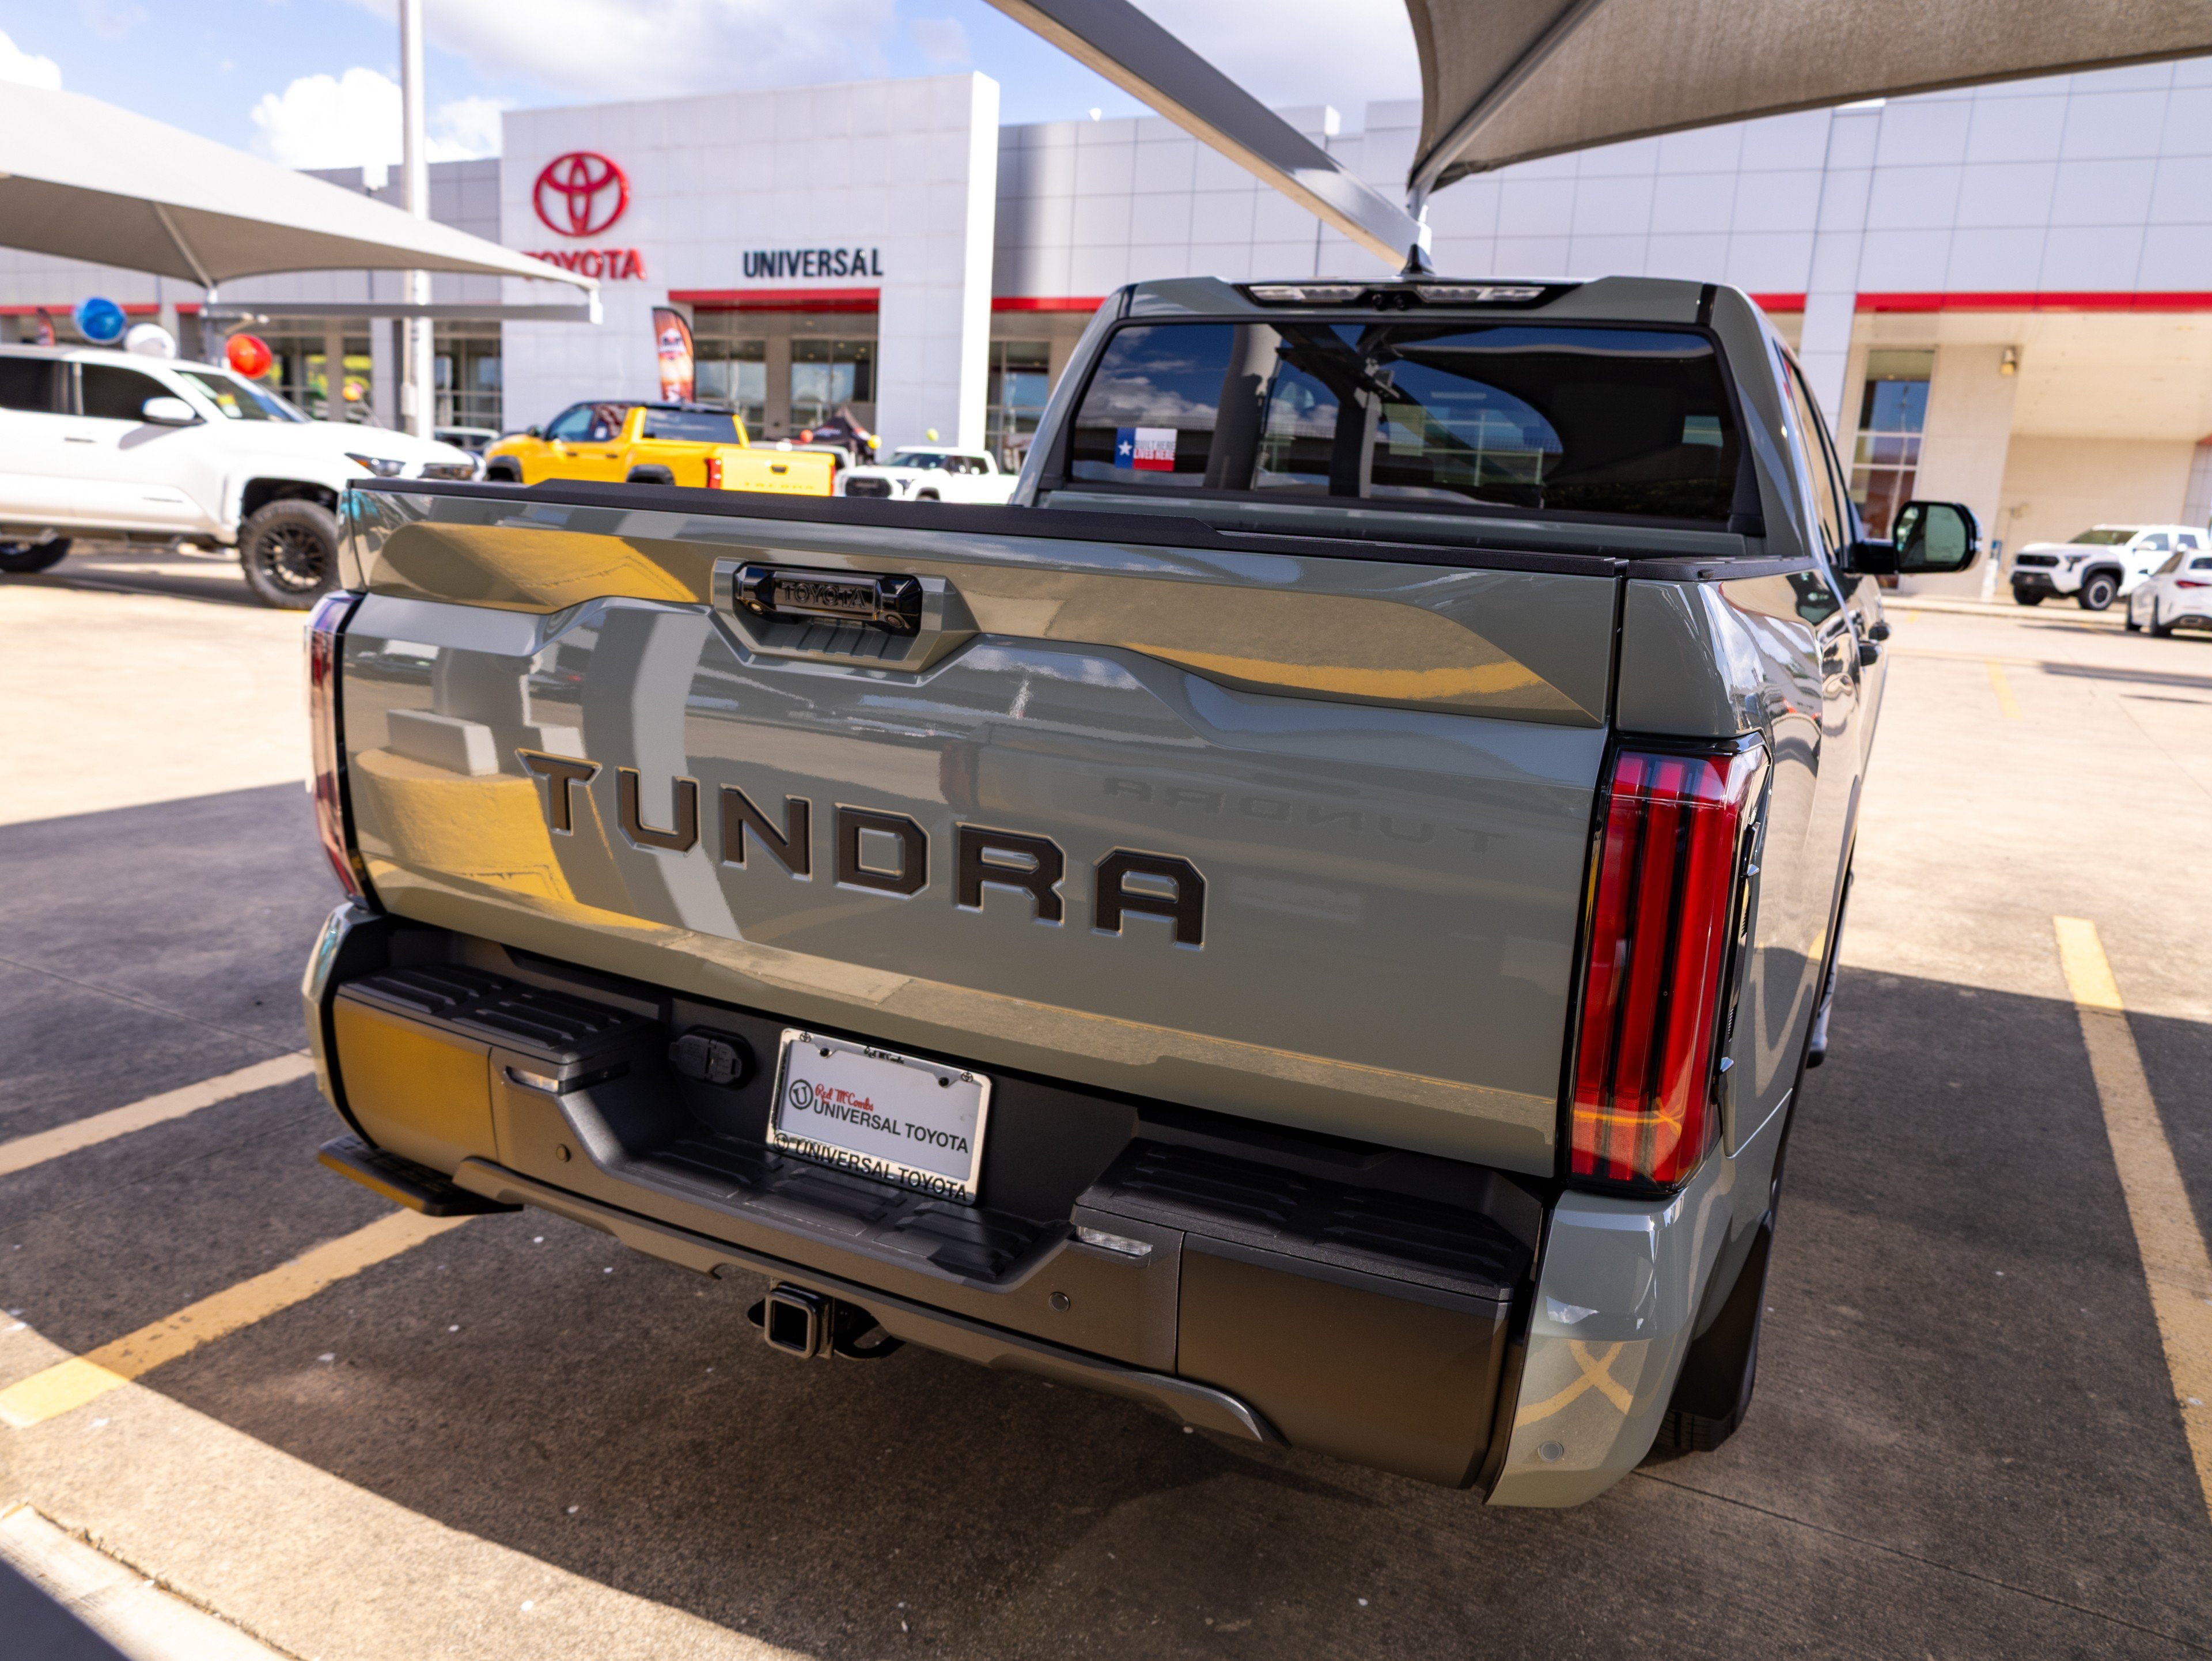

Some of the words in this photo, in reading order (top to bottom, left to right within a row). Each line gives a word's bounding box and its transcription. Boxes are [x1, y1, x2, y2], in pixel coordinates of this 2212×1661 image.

[743, 247, 884, 278] UNIVERSAL
[781, 580, 865, 609] TOYOTA
[517, 748, 1207, 951] TUNDRA
[815, 1083, 833, 1102] Red
[835, 1088, 874, 1111] McCombs
[813, 1098, 901, 1136] UNIVERSAL
[905, 1122, 969, 1154] TOYOTA
[796, 1138, 894, 1180] UNIVERSAL
[898, 1166, 967, 1202] TOYOTA
